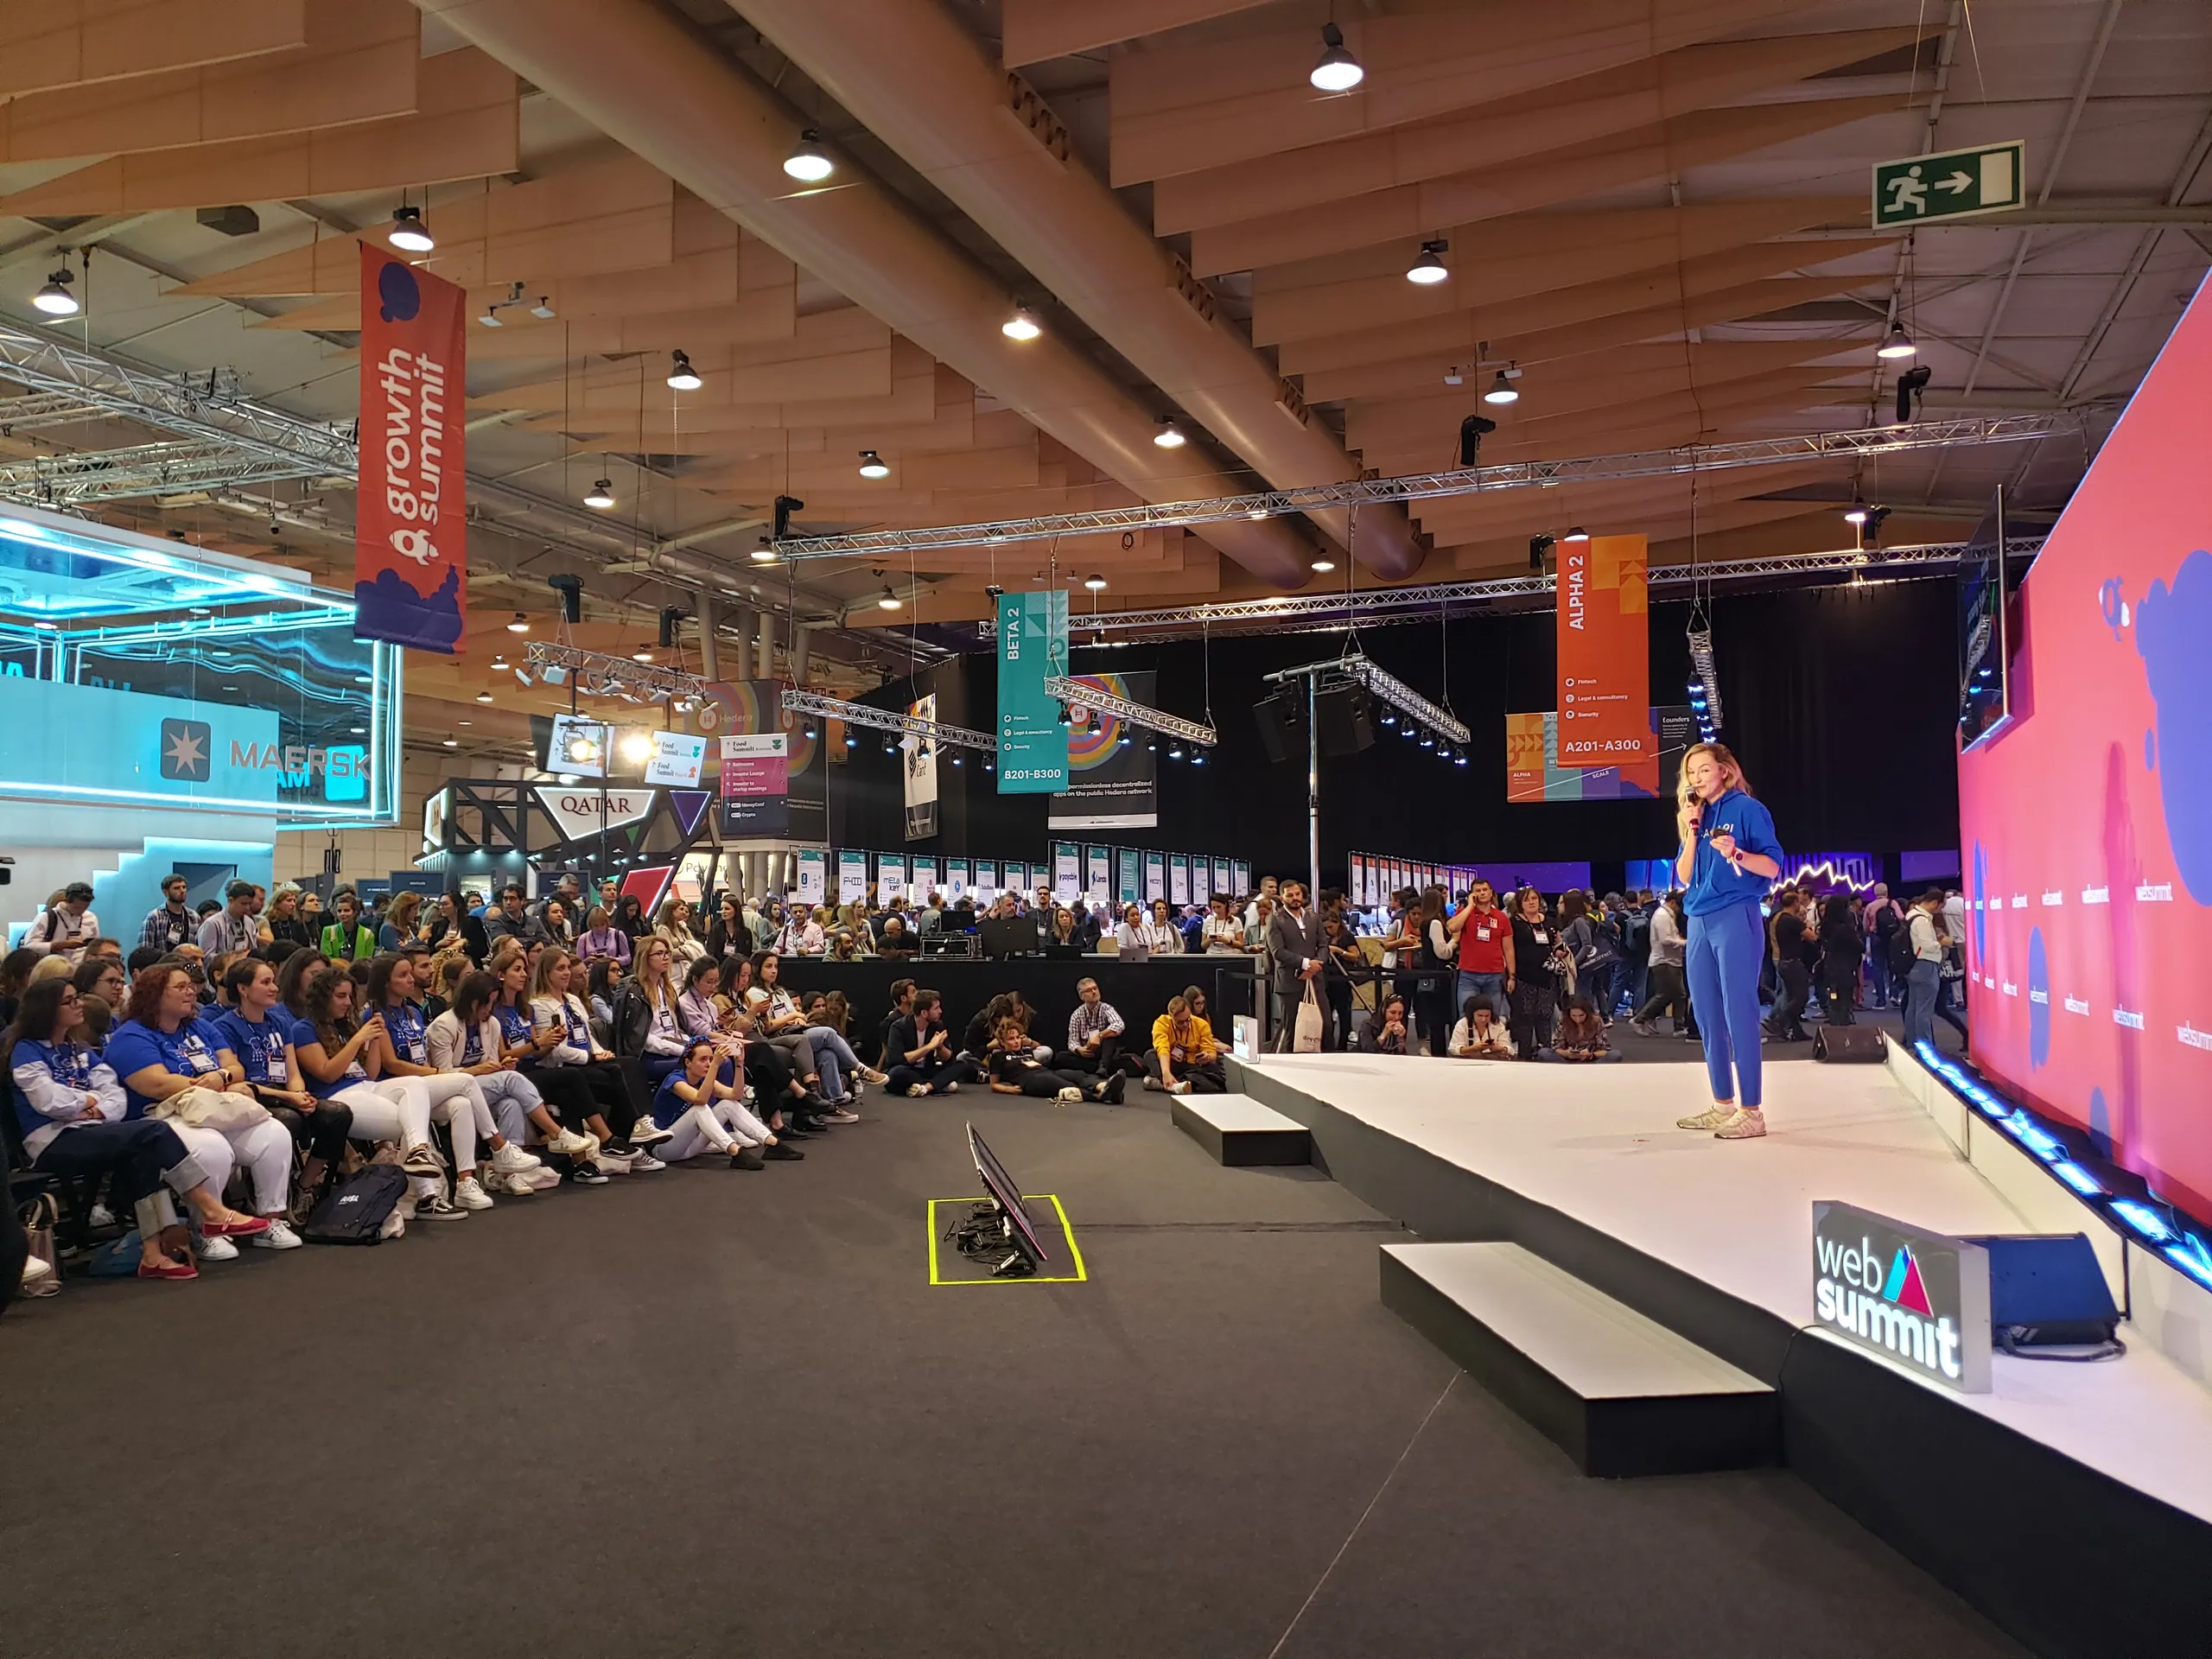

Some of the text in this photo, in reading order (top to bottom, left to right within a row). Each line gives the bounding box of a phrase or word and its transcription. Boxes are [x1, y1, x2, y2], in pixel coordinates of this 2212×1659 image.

[378, 346, 418, 521] growth
[413, 352, 445, 525] summit
[1568, 554, 1584, 630] ALPHA 2
[1007, 607, 1020, 660] BETA 2
[230, 739, 371, 781] MAERSK
[1565, 740, 1641, 753] A201-A300
[1004, 768, 1061, 779] B201-B300
[1087, 789, 1103, 798] public
[1592, 770, 1610, 779] SCALE
[561, 796, 633, 816] QATAR
[1815, 1235, 1883, 1294] web
[1815, 1278, 1960, 1379] summit
